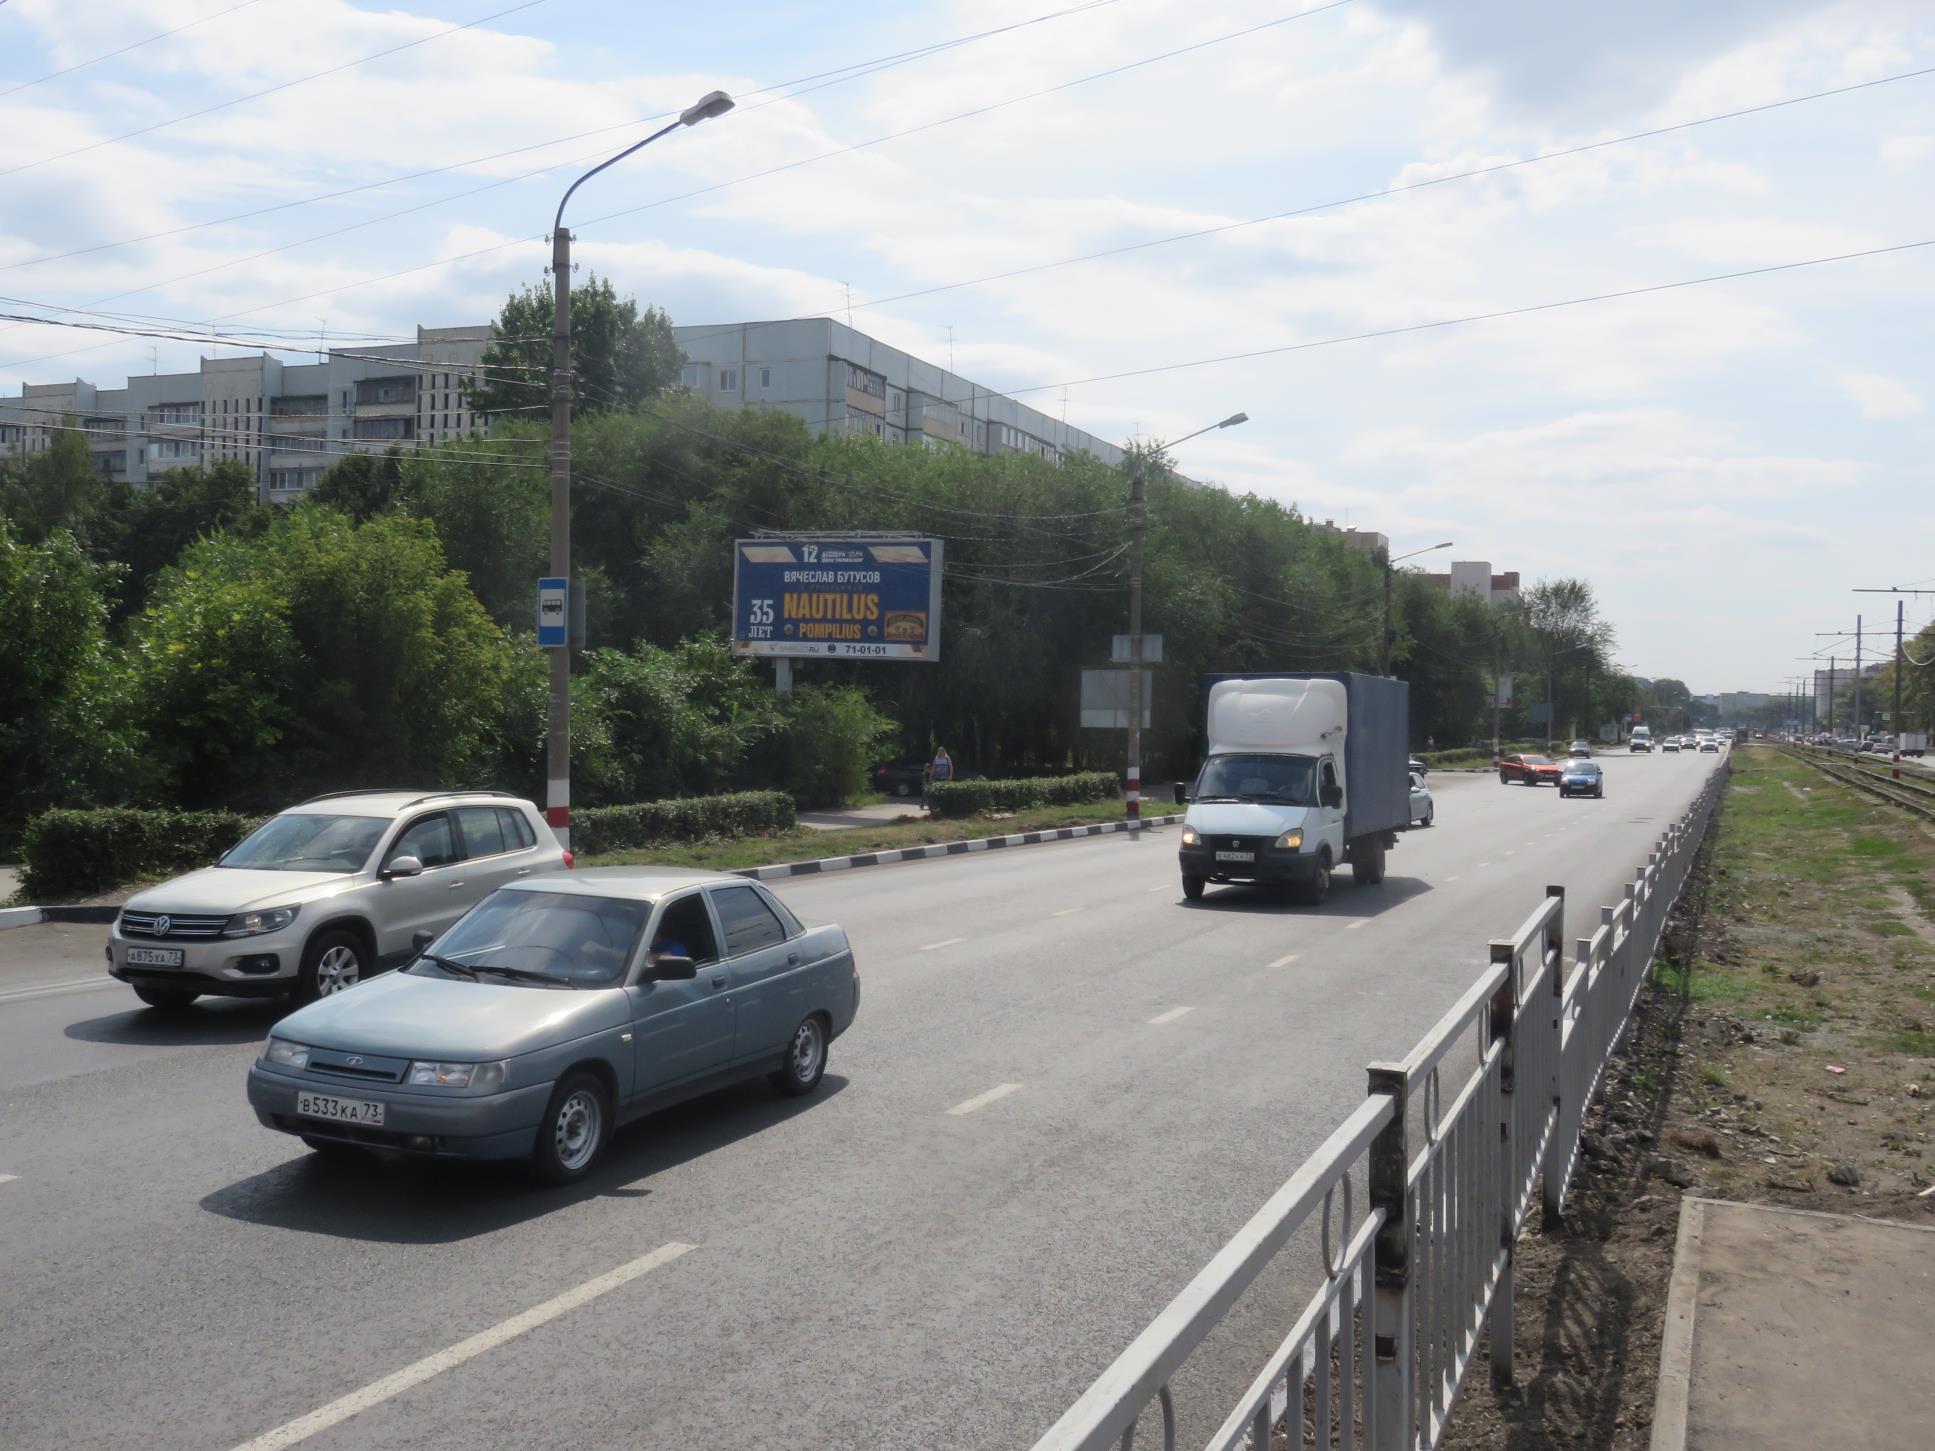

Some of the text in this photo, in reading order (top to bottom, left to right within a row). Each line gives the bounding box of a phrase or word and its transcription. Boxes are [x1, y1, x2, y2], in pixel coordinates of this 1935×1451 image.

[801, 544, 818, 562] 12
[784, 571, 880, 583] ВЯЧЕСЛАВ БУТУСОВ
[749, 599, 775, 624] 35
[783, 592, 879, 620] NAUTILUS
[748, 625, 773, 638] ЛЕТ
[799, 623, 861, 639] POMPILIUS
[845, 645, 887, 654] 71-01-01
